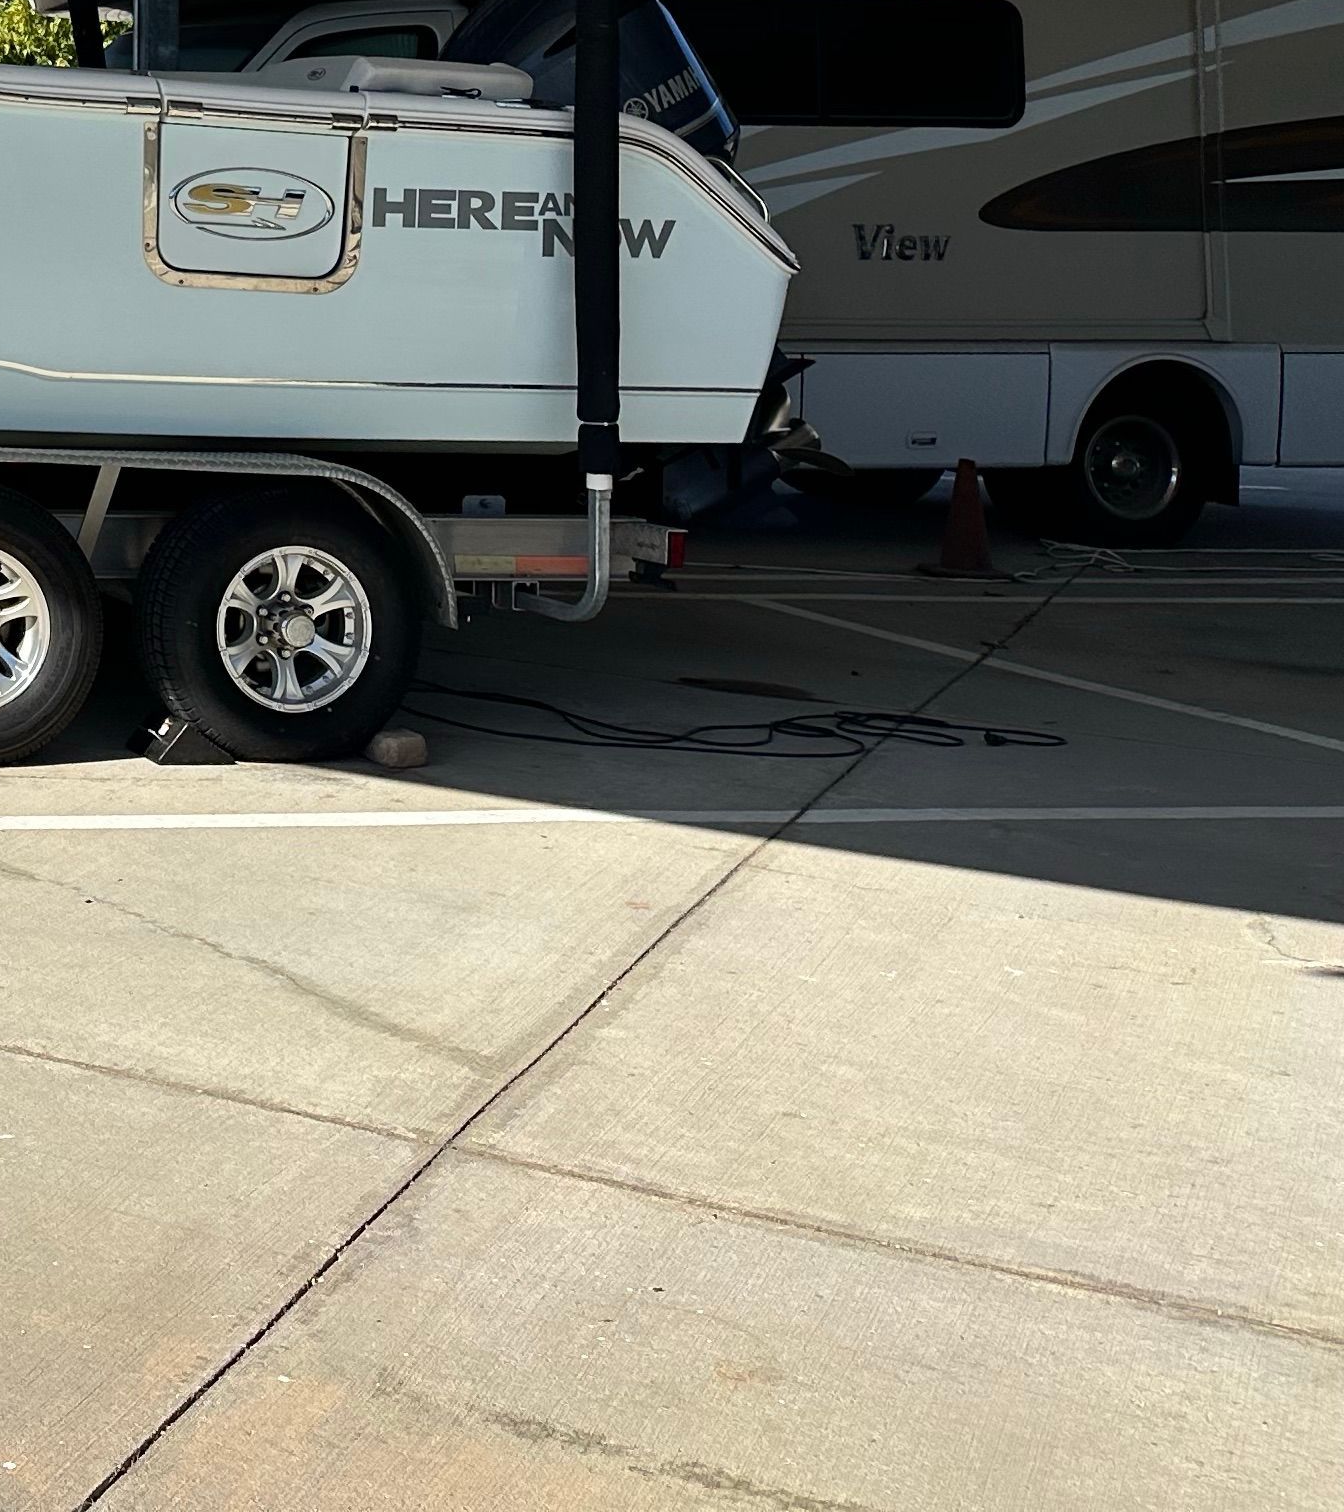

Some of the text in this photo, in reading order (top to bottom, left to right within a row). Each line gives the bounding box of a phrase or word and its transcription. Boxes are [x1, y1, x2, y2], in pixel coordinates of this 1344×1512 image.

[643, 67, 703, 113] YAMAH
[371, 187, 575, 232] HERE AN
[542, 218, 677, 260] NW
[852, 223, 951, 261] View
